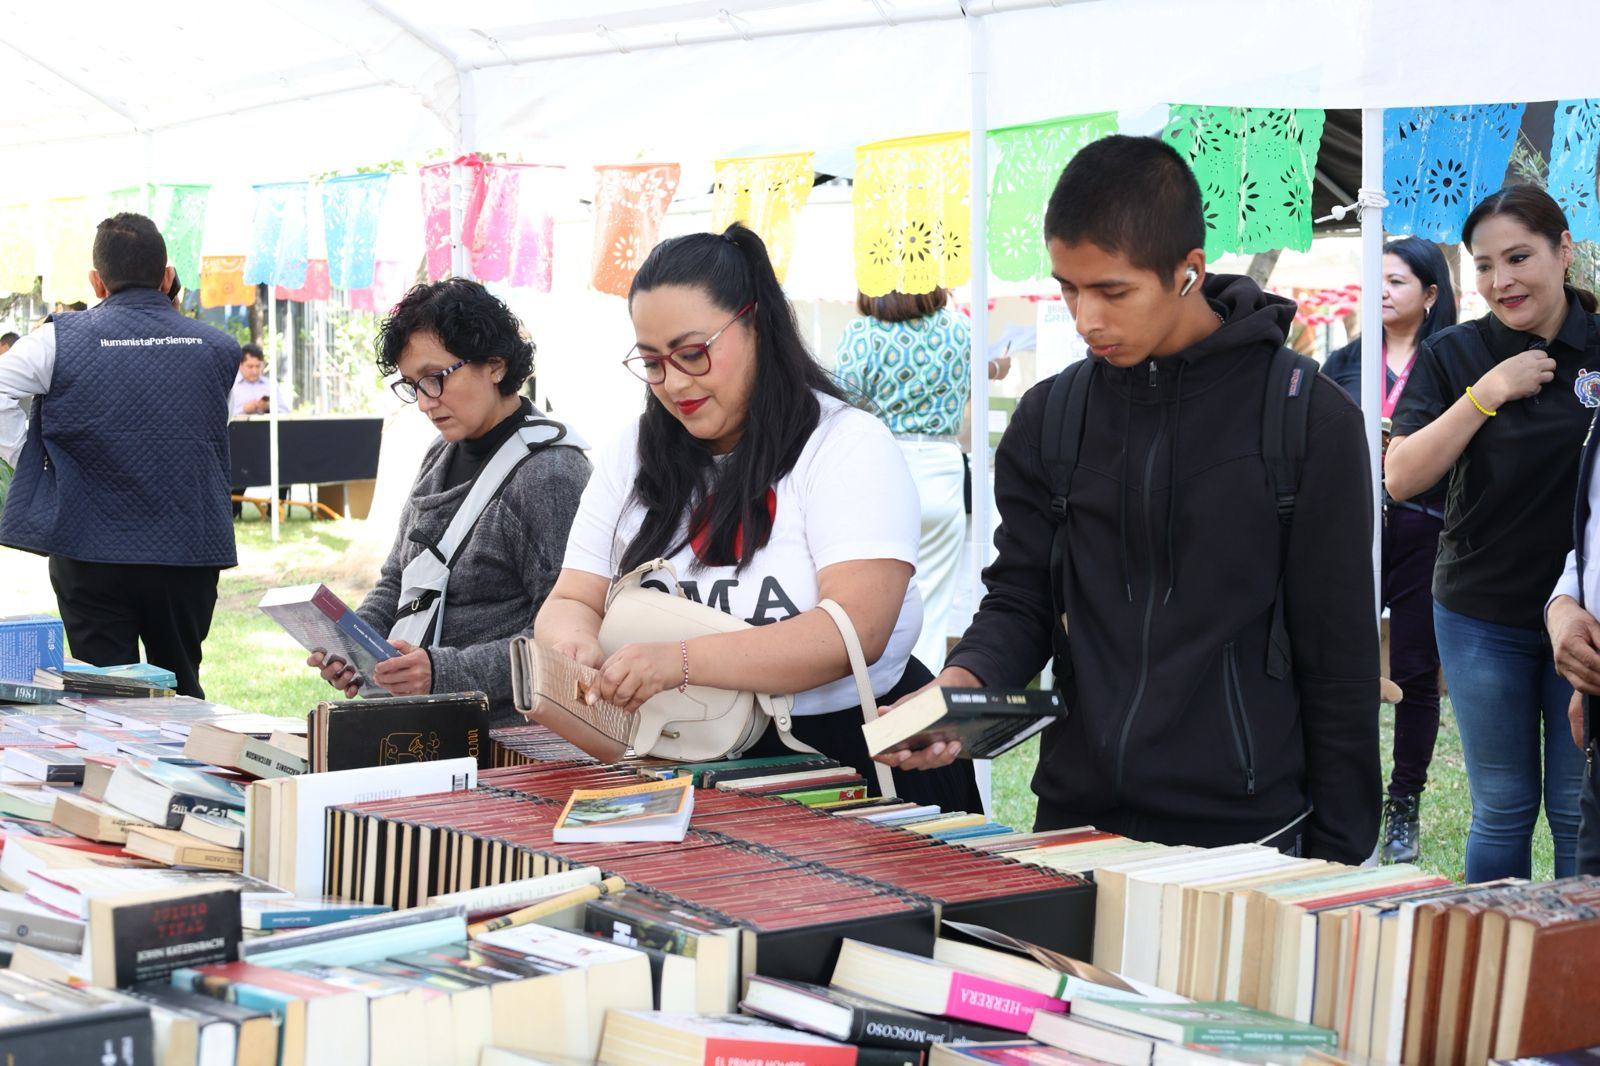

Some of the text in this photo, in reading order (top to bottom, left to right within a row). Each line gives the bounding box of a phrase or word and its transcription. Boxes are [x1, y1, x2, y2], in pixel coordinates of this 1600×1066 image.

[100, 336, 203, 347] HumanistaPorSiempre
[960, 987, 1021, 1015] HERRERA
[866, 1022, 926, 1043] MOSCOSO
